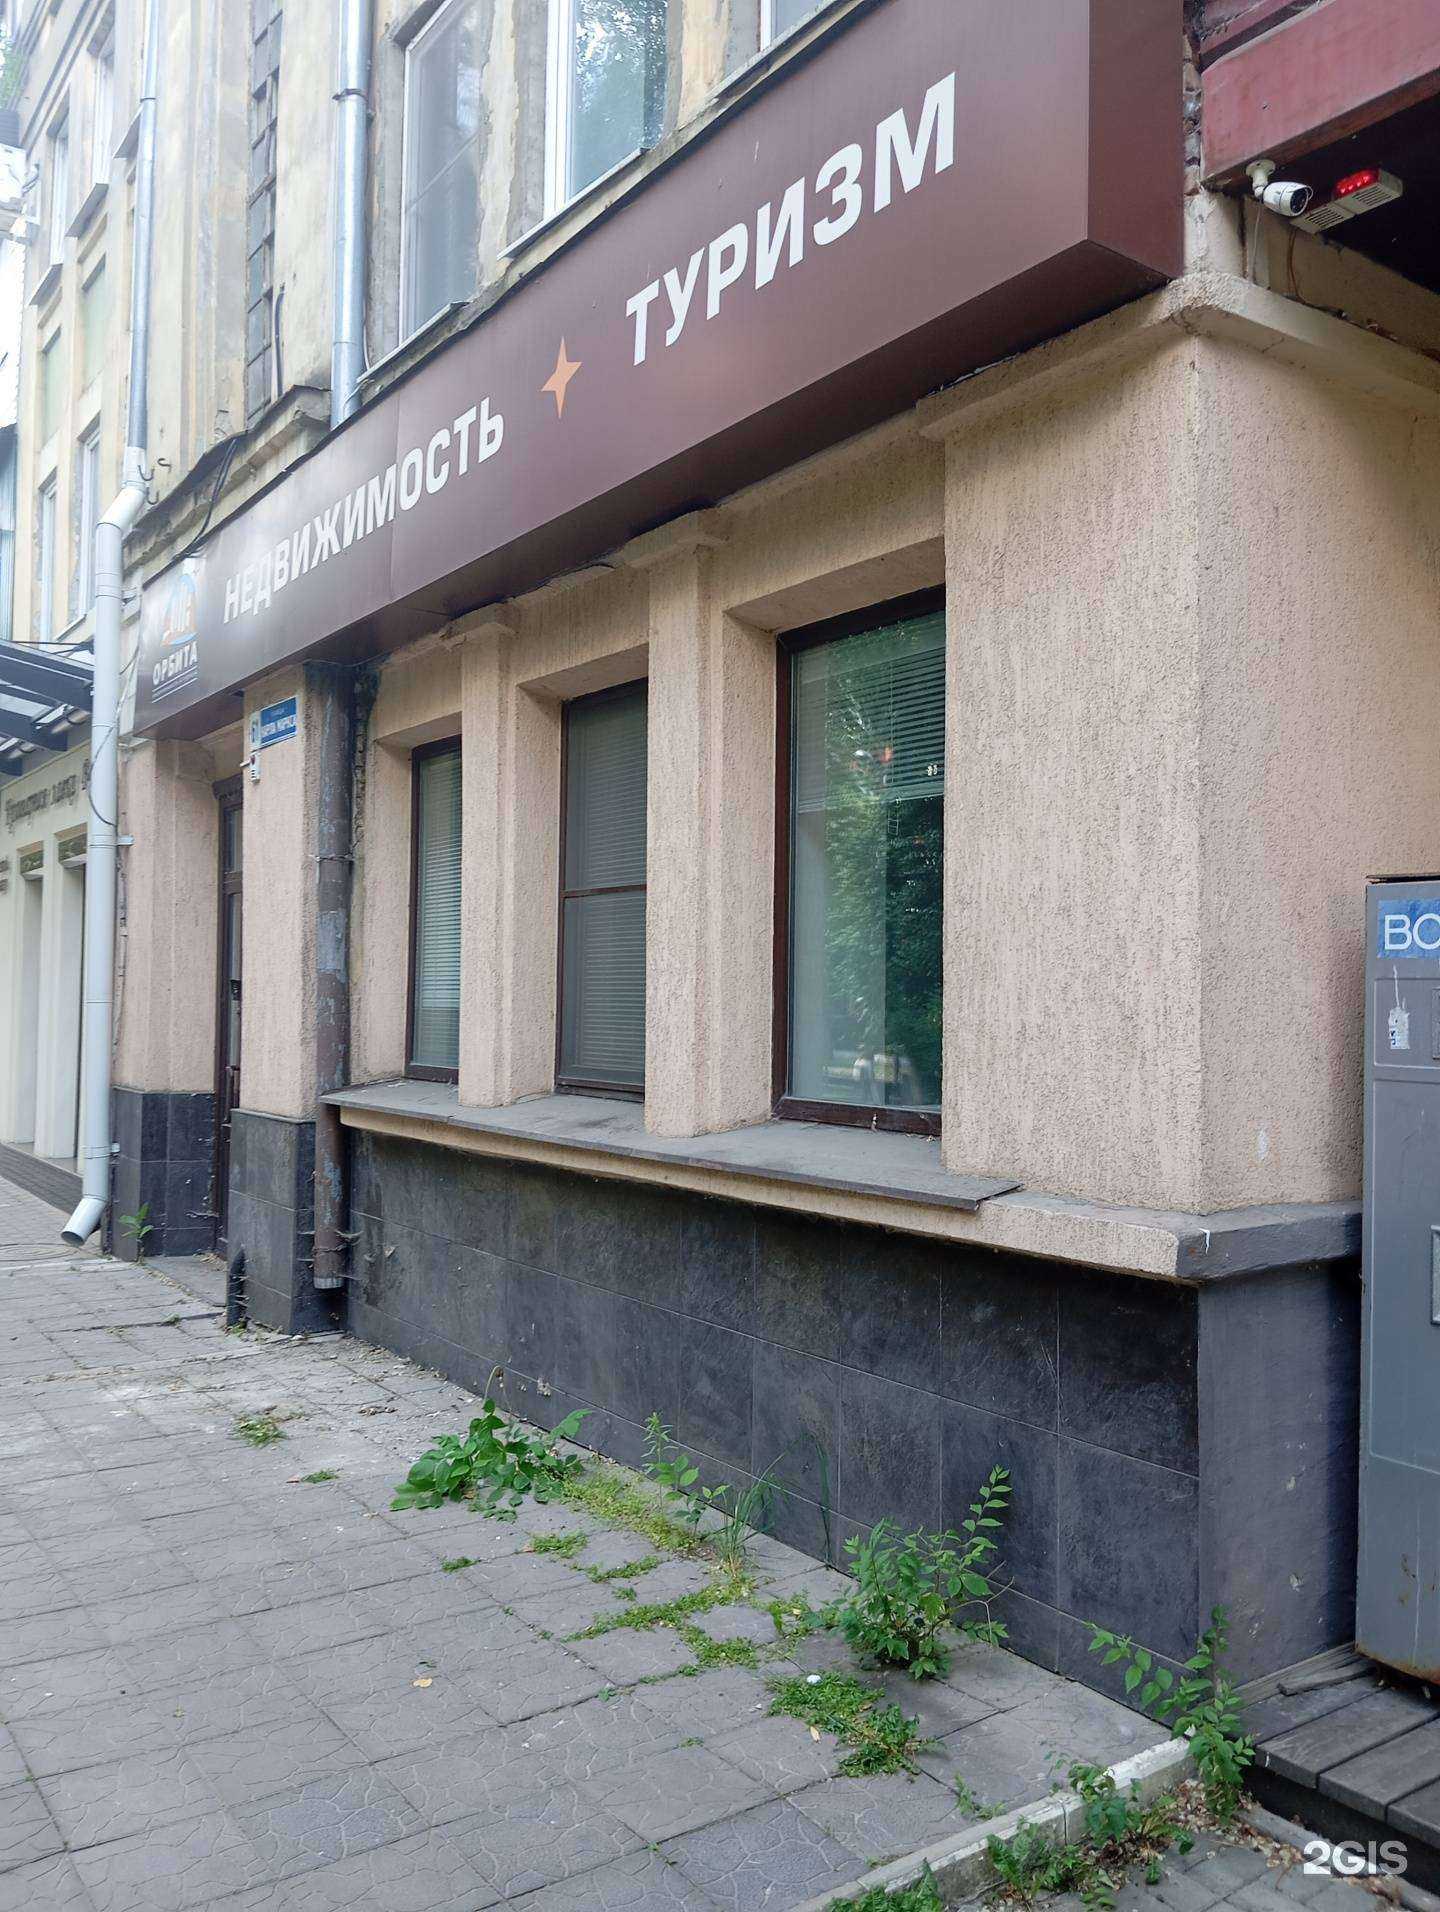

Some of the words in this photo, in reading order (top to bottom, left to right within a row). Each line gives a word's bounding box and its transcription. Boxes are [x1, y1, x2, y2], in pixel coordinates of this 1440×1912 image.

[223, 397, 504, 624] НЕДВИЖИМОСТЬ
[626, 71, 956, 366] ТУРИЗМ
[152, 640, 198, 686] ОРБИТА
